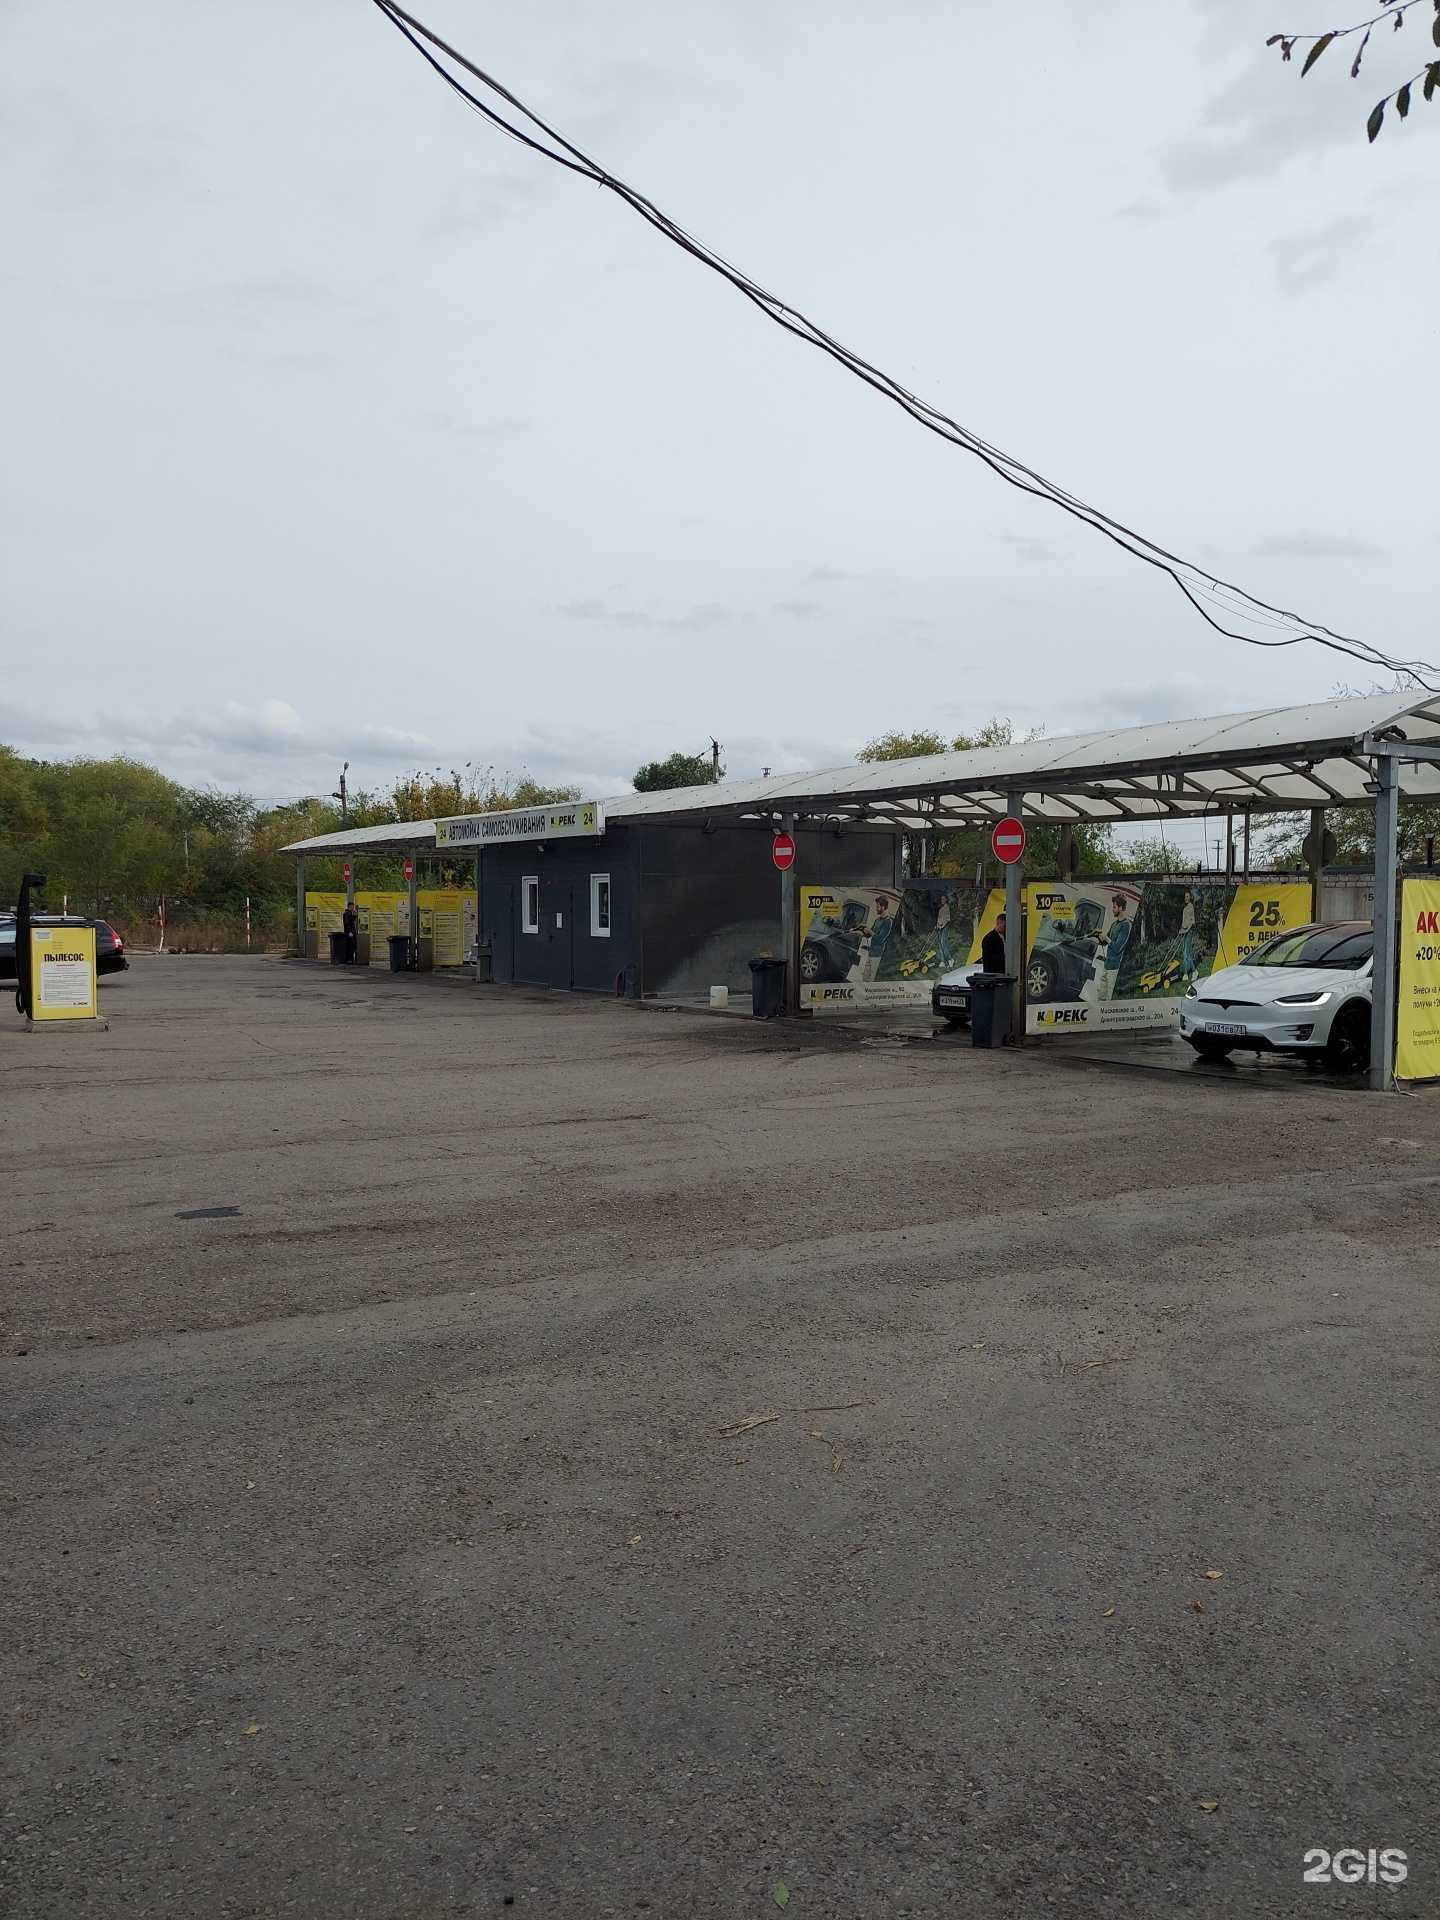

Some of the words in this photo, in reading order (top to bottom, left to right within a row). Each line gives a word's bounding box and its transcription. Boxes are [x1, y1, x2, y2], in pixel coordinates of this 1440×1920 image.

[448, 820, 480, 841] АВТОМОЙКА
[481, 815, 546, 837] САМООБСЛУЖИВАНИЯ
[583, 812, 593, 826] 24
[1249, 900, 1286, 927] 25%
[1248, 931, 1255, 941] В
[44, 953, 84, 963] ПЫЛЕСОС
[1036, 1008, 1089, 1024] КАРЕКС
